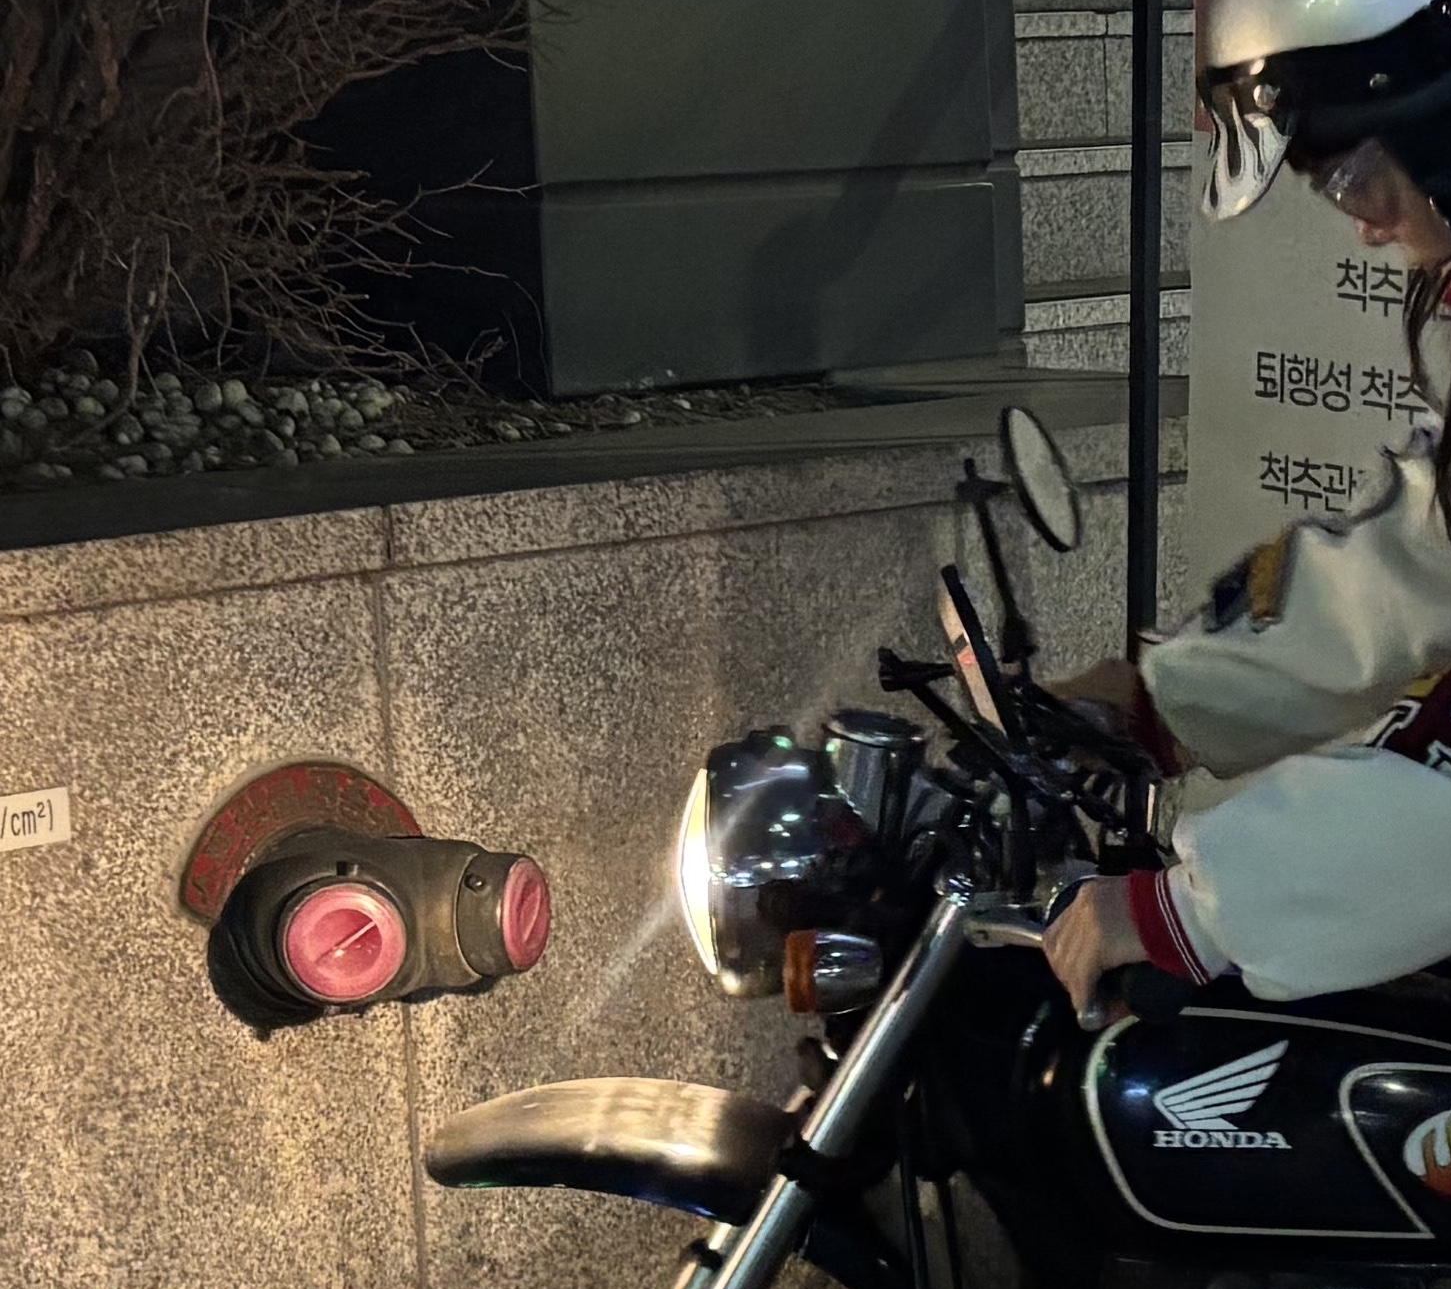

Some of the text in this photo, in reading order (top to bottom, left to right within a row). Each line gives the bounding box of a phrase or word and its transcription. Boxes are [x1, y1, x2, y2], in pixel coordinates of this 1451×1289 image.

[1336, 257, 1415, 317] 척추
[1255, 351, 1430, 426] 퇴행성 척추
[1260, 450, 1364, 512] 척추관
[1152, 1129, 1293, 1150] HONDA
